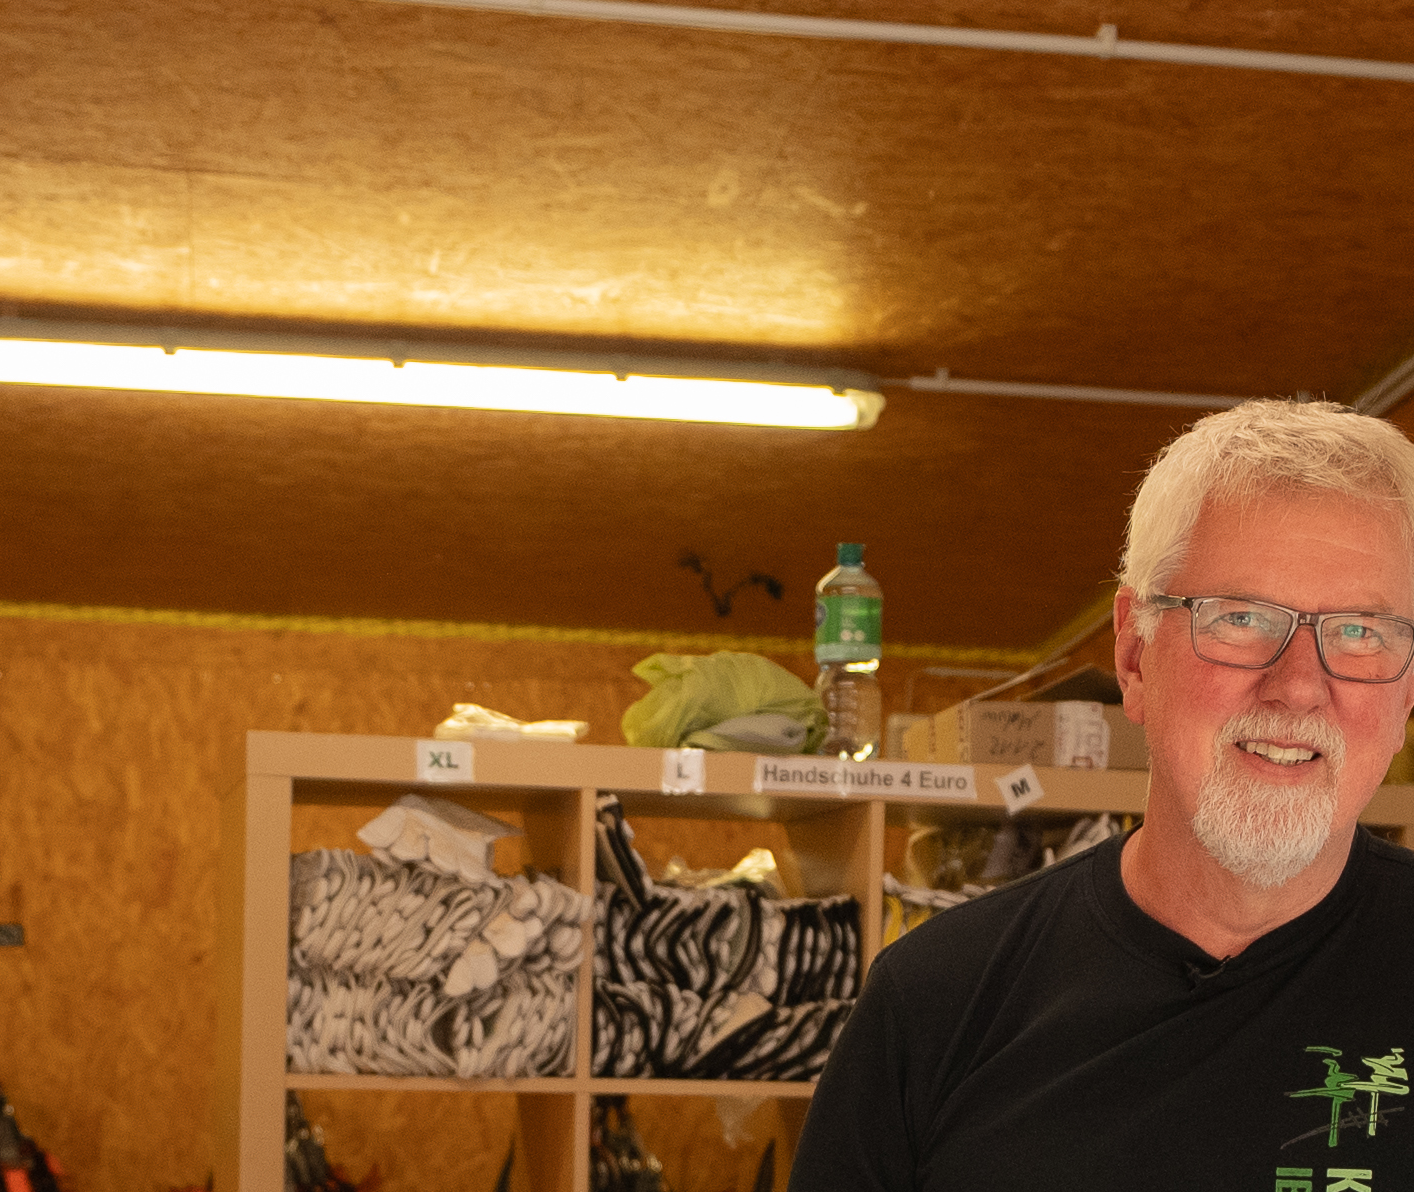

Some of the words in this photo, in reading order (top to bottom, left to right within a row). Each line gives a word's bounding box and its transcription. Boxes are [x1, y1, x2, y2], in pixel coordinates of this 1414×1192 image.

[428, 751, 460, 769] XL
[676, 762, 691, 780] L
[763, 763, 894, 788] Handschuhe
[900, 772, 913, 788] 4
[919, 771, 968, 791] Euro
[1009, 777, 1032, 799] M
